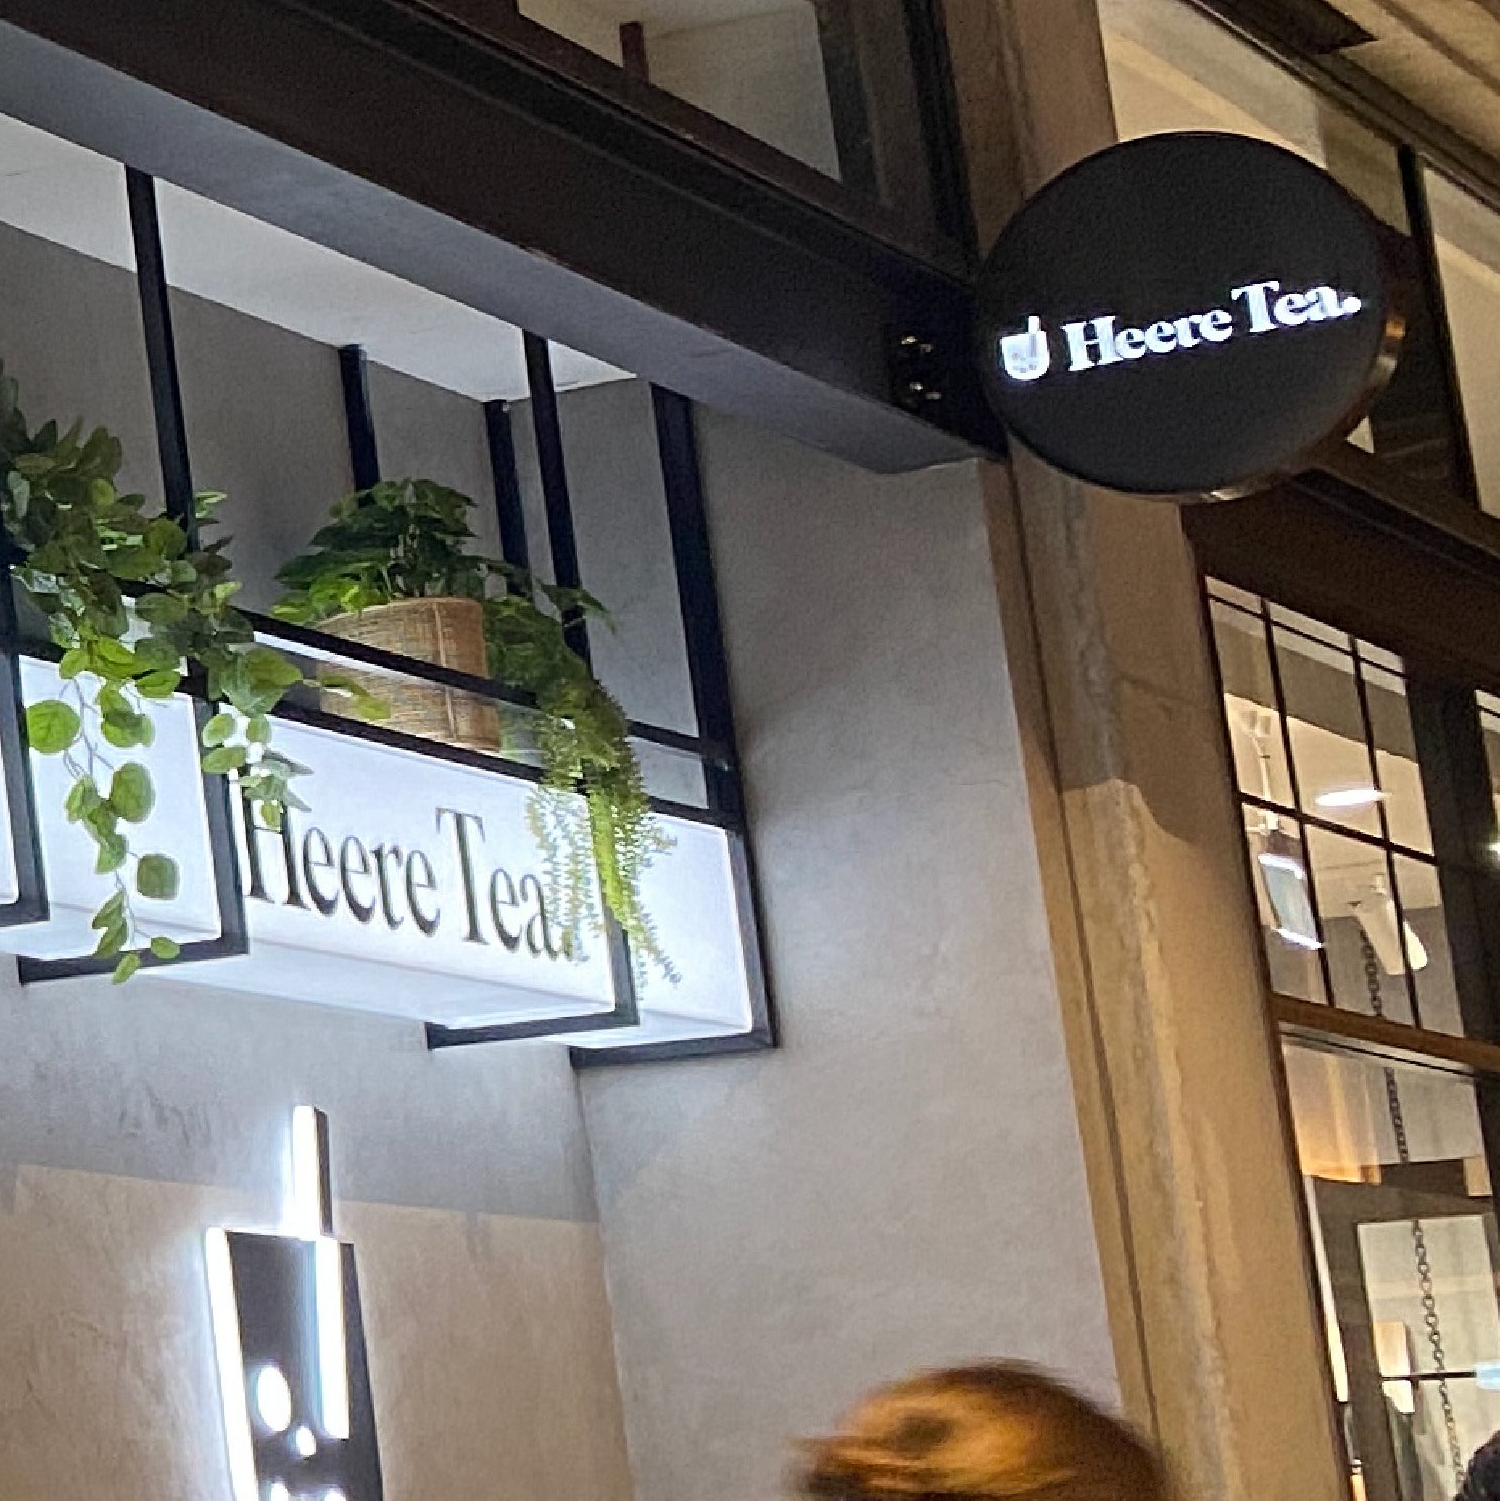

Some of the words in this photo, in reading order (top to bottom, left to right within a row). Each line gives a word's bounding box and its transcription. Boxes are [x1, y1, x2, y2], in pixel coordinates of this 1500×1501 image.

[1062, 309, 1233, 372] Heere
[1231, 280, 1362, 333] Tea.
[241, 782, 443, 938] Heere
